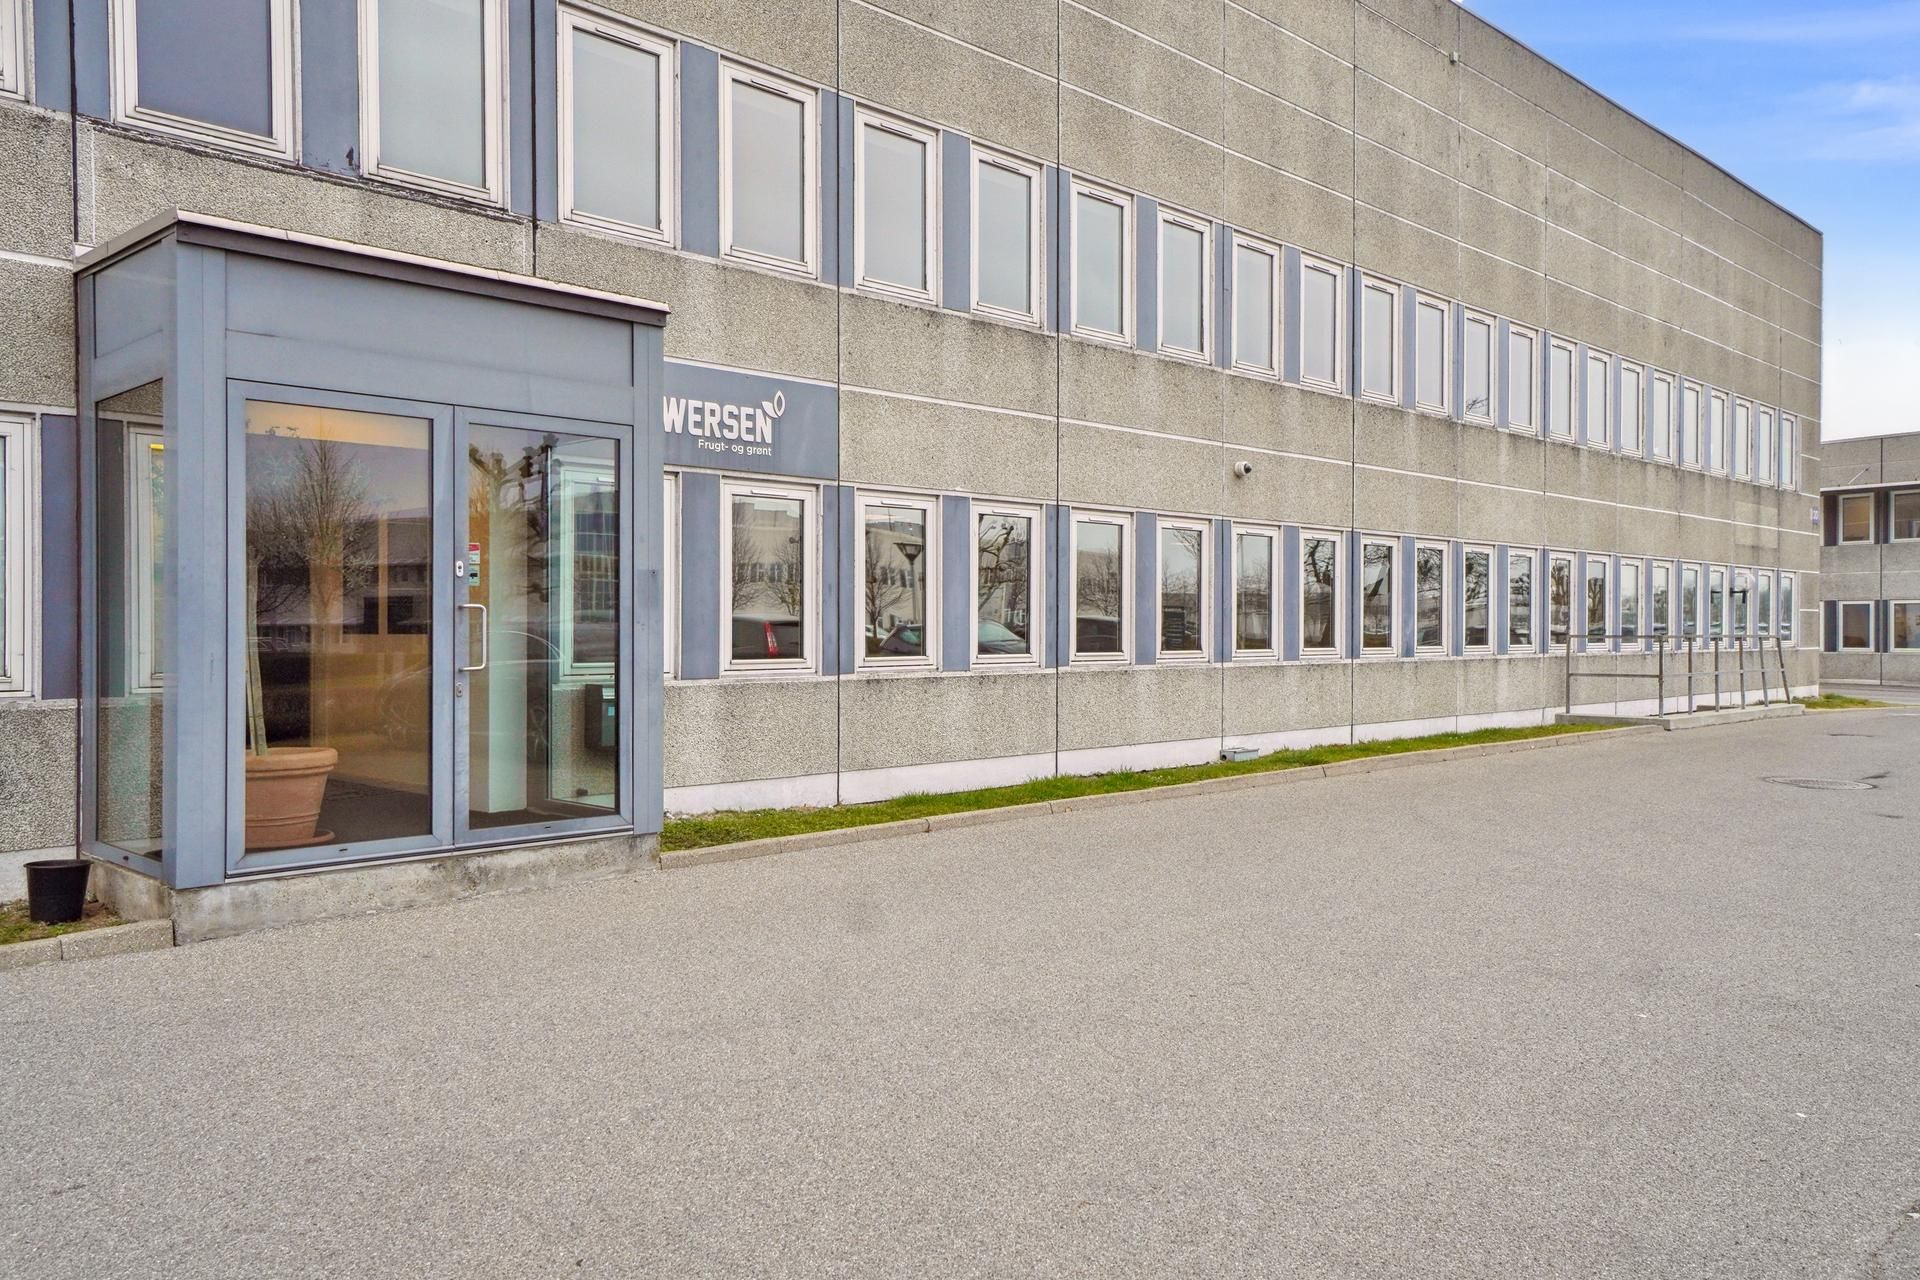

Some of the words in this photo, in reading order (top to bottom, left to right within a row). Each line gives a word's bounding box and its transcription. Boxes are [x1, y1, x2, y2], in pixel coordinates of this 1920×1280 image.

[663, 395, 772, 444] WERSEN
[698, 439, 729, 453] Frugt-
[731, 444, 744, 455] og
[746, 446, 772, 456] grønt
